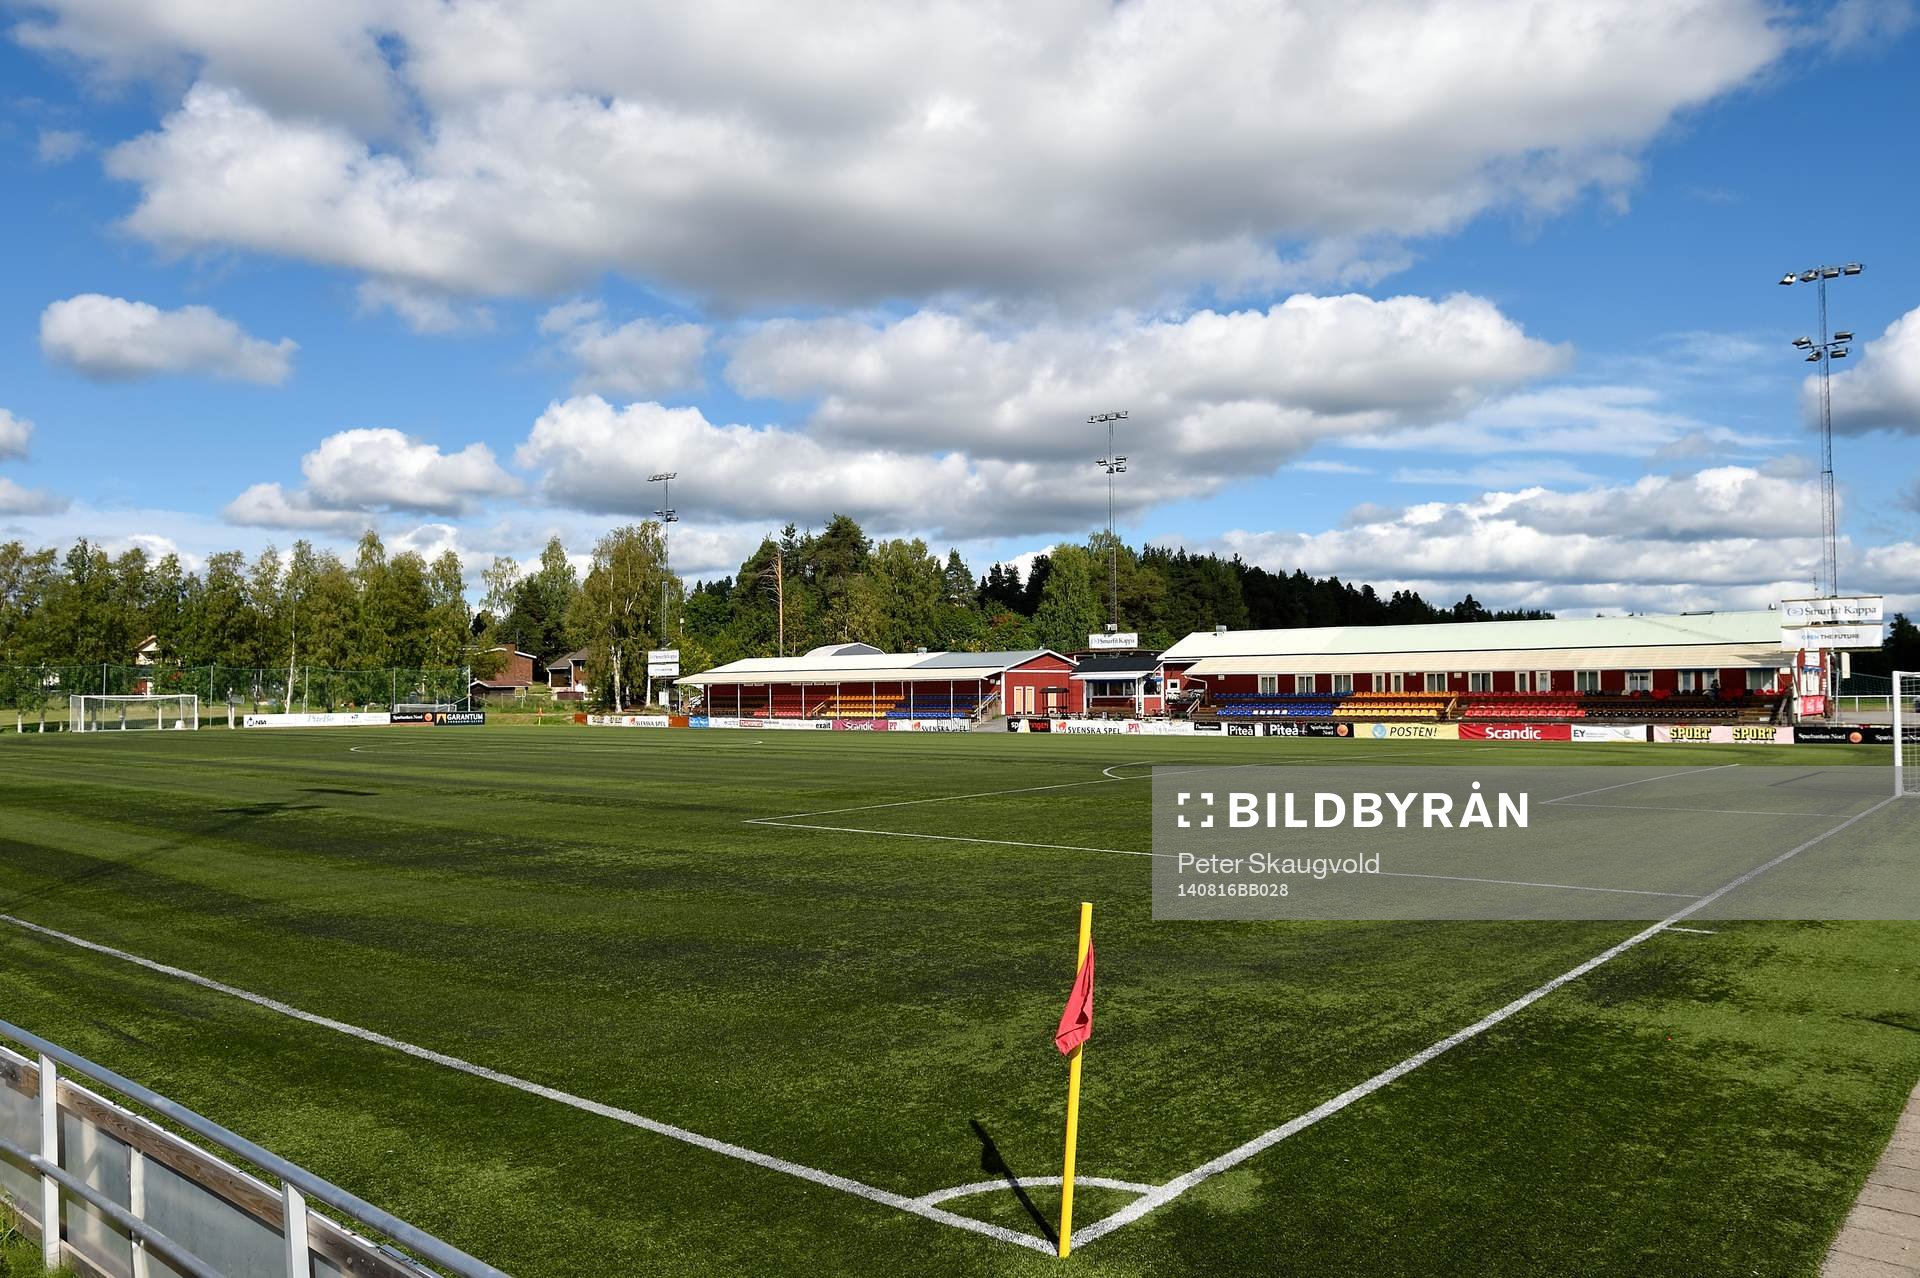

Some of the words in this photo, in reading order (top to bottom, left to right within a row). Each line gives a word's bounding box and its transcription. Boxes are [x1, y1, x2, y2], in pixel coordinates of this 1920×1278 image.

[1844, 606, 1876, 617] Kappa
[845, 720, 874, 731] Scandic
[889, 722, 897, 730] PT
[1103, 727, 1122, 735] SPEL
[1229, 725, 1254, 736] Piteå
[1389, 726, 1437, 737] POSTEN!
[1485, 726, 1541, 740] Scandic
[1573, 730, 1586, 738] EY
[1670, 727, 1712, 740] SPORT
[1732, 727, 1777, 741] SPORT
[1831, 733, 1846, 741] Nord
